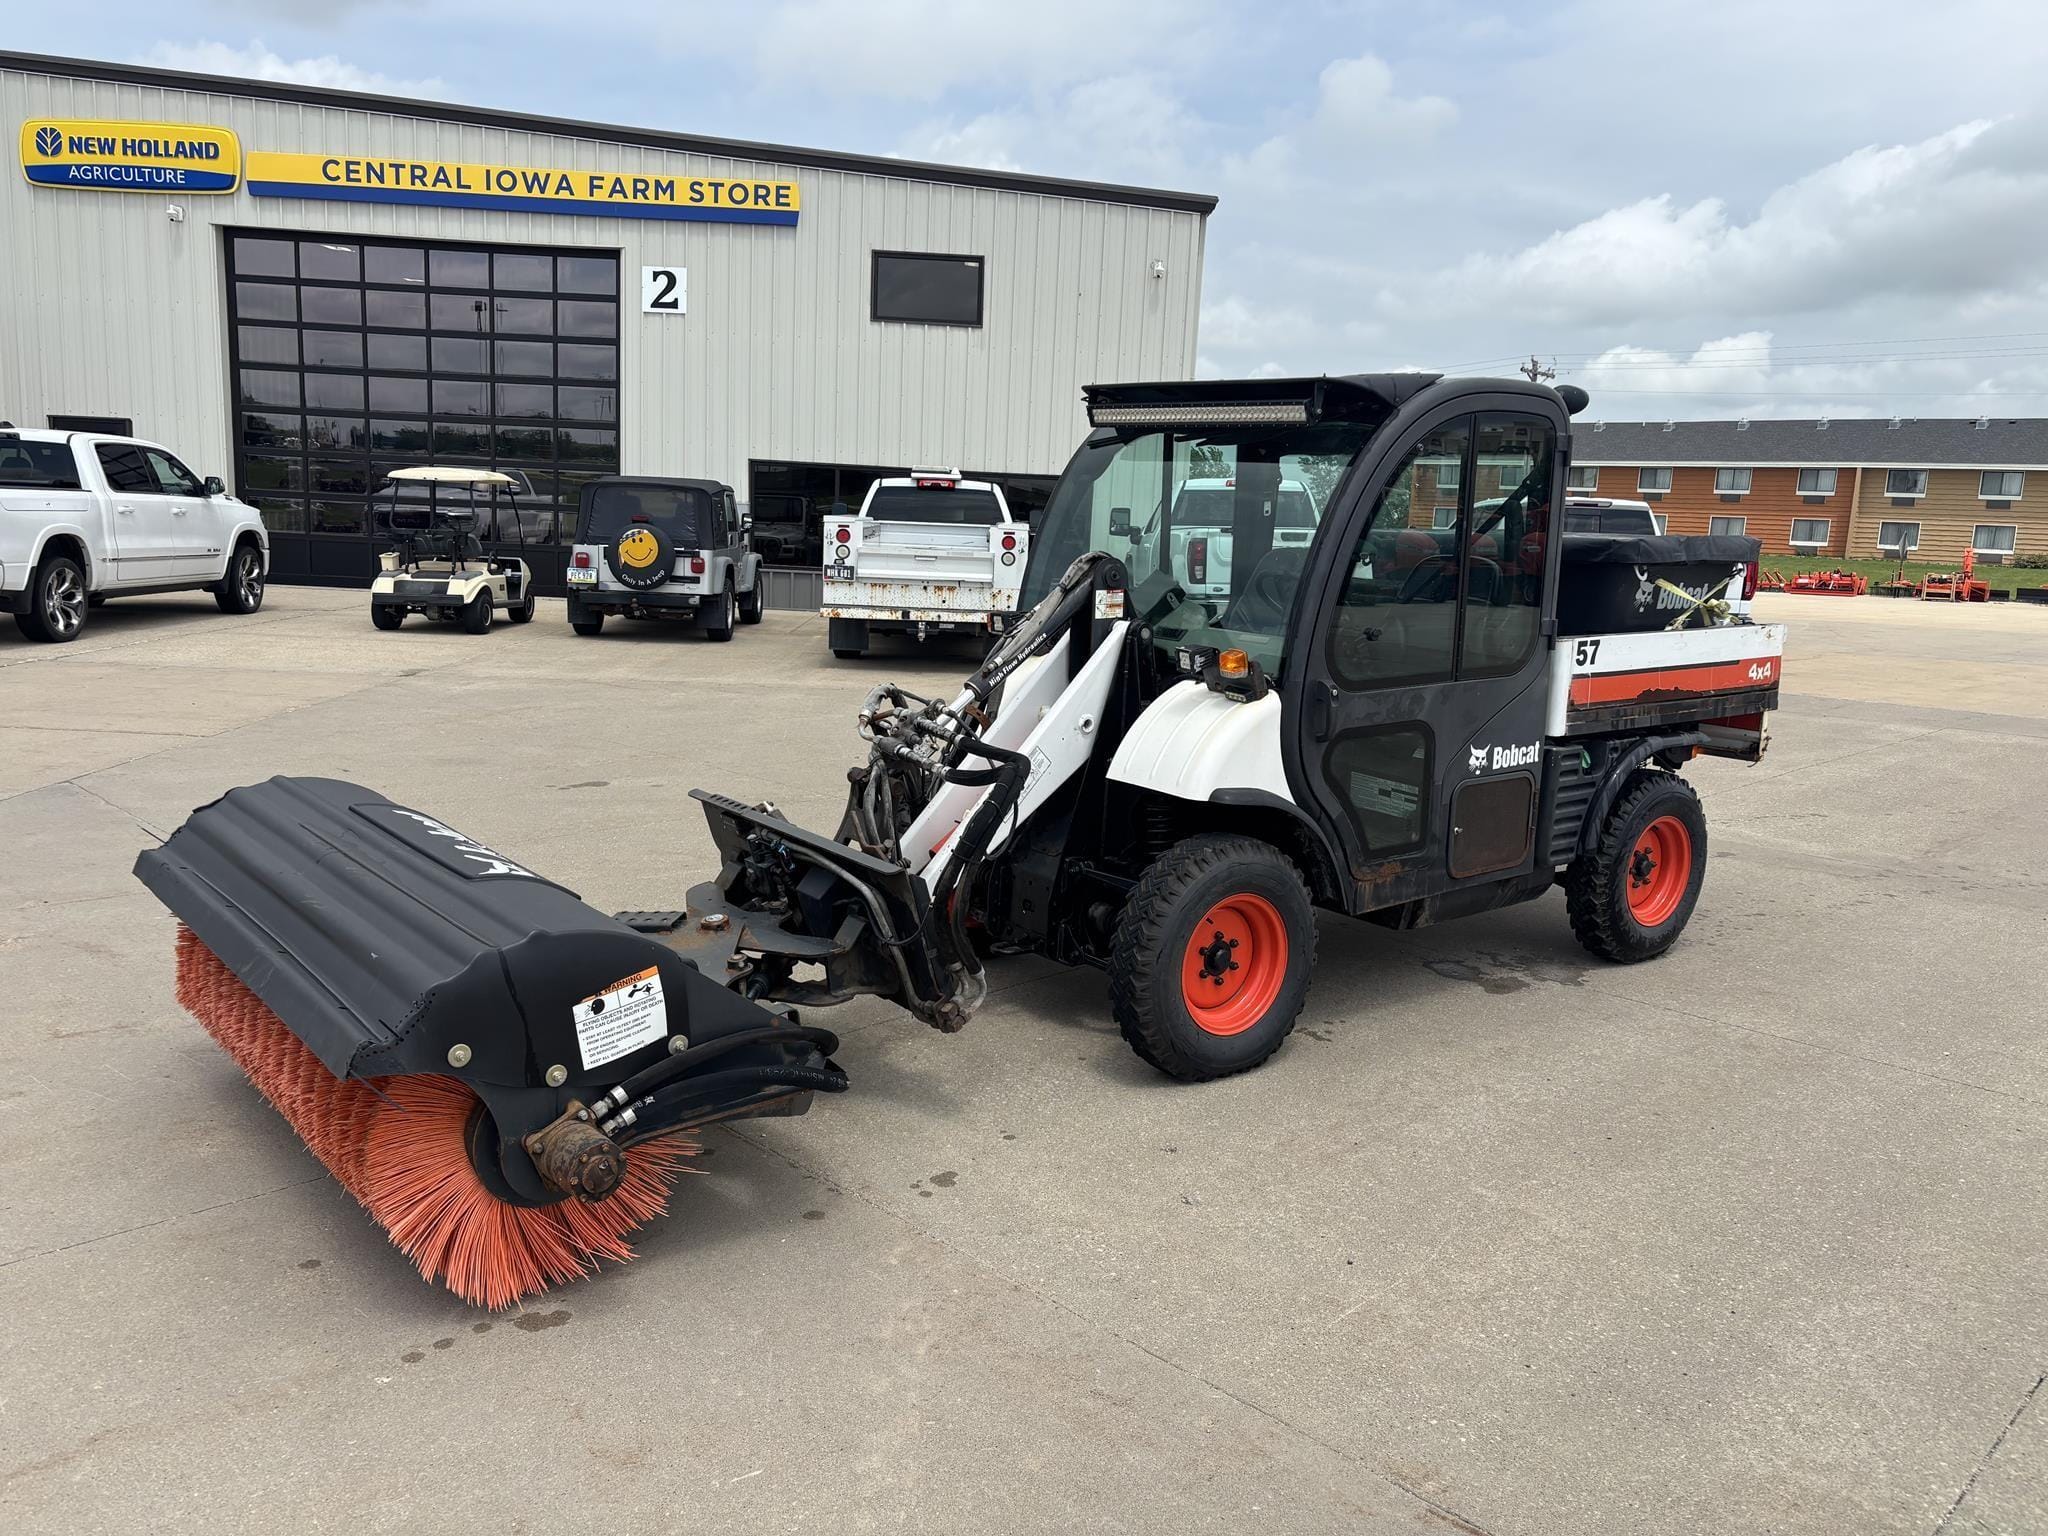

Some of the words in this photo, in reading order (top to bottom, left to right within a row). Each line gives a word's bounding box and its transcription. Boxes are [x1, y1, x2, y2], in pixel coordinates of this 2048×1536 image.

[68, 135, 114, 156] NEW
[121, 138, 220, 160] HOLLAND
[68, 165, 186, 184] AGRICULTURE
[321, 158, 472, 190] CENTRAL
[484, 169, 576, 197] IOWA
[588, 175, 676, 202] FARM
[688, 182, 792, 208] STORE
[649, 270, 679, 310] 2
[621, 573, 636, 586] Only
[652, 569, 665, 582] Jeep
[989, 671, 1004, 687] High
[1002, 659, 1018, 674] Flow
[1017, 633, 1047, 660] Hydraulics
[1575, 639, 1601, 667] 57
[1748, 661, 1772, 681] 4x4
[1492, 740, 1541, 770] Bobcat
[604, 973, 642, 993] WARNING
[579, 1026, 594, 1034] PARTS
[607, 1016, 622, 1024] CAUSE
[623, 1009, 640, 1017] INJURY
[649, 1000, 663, 1008] DEATH
[582, 1016, 600, 1027] FLYING
[600, 1010, 623, 1020] OBJECTS
[634, 996, 656, 1008] ROTATING
